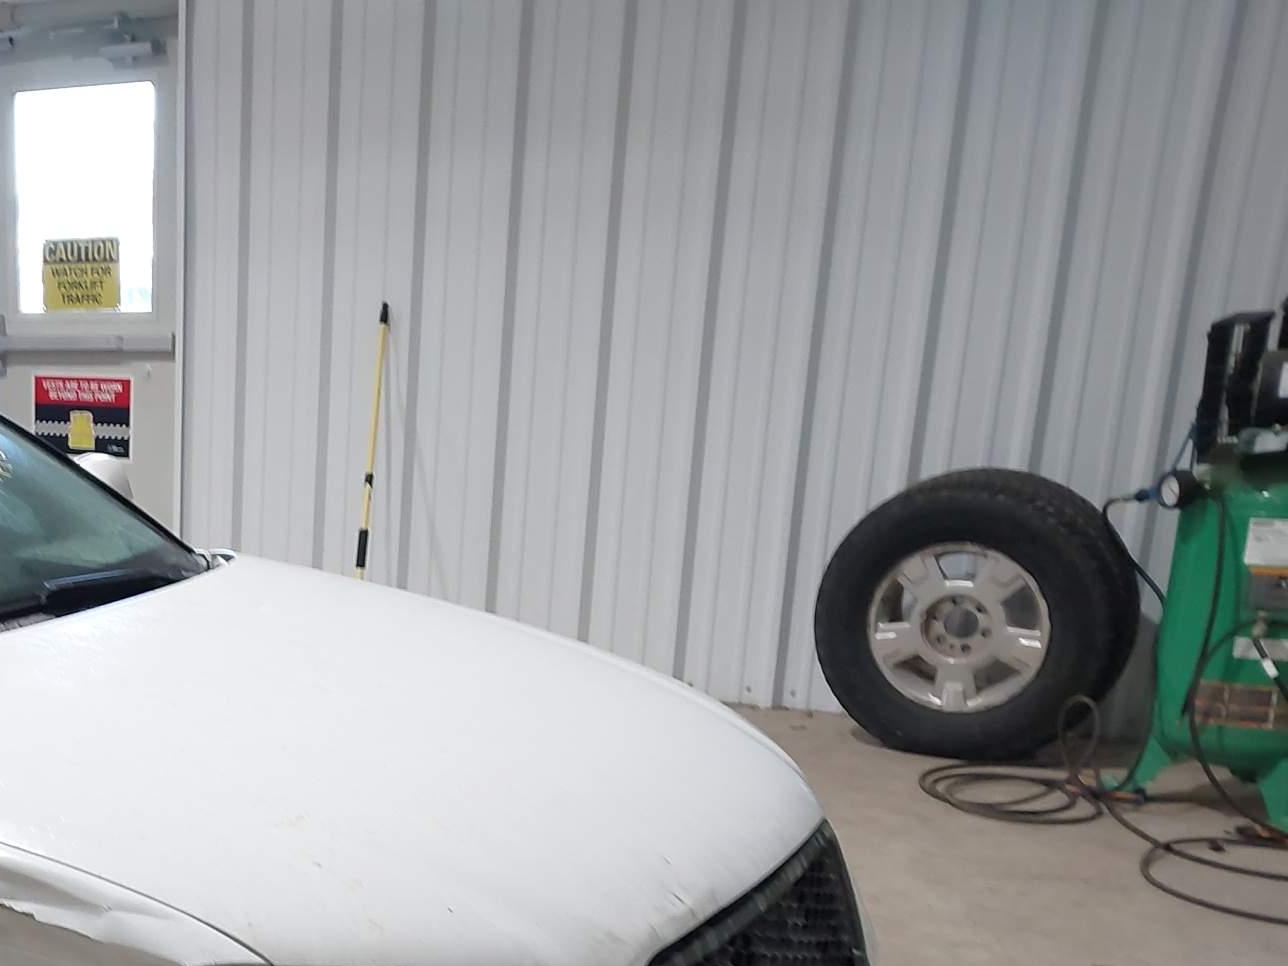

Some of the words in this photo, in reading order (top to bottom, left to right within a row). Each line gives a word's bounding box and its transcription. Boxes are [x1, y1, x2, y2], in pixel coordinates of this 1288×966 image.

[44, 240, 118, 262] CAUTION
[51, 265, 88, 278] WATCH
[91, 265, 112, 278] FOR
[57, 280, 104, 291] FORKLIFT
[61, 293, 103, 304] TRAFFIC
